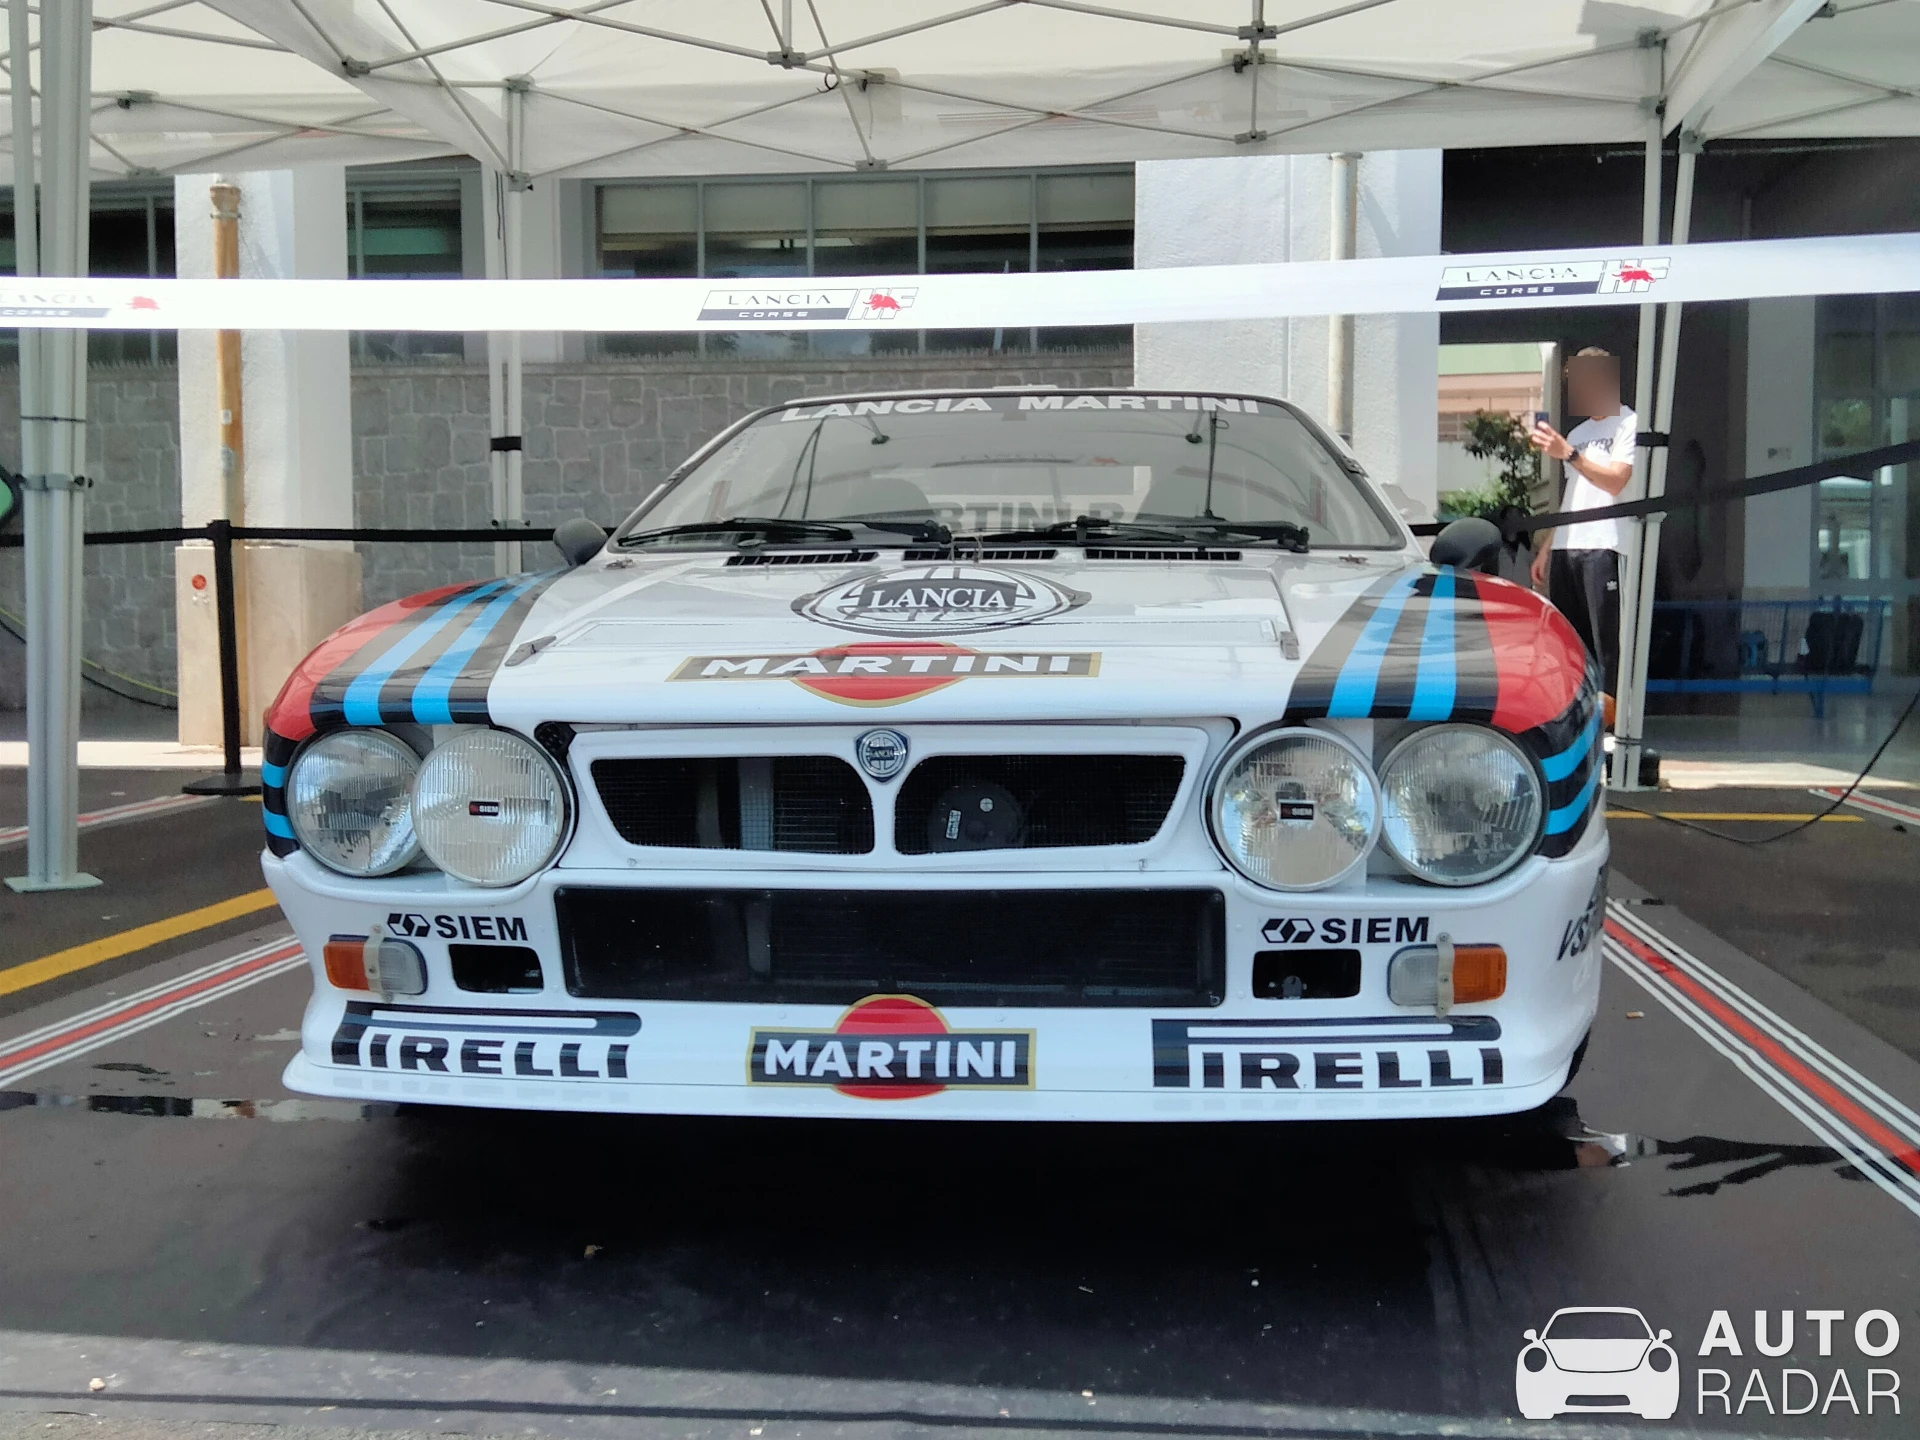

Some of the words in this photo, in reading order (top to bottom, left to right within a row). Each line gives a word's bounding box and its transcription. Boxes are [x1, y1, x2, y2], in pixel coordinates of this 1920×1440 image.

[1466, 267, 1578, 283] LANCIA
[728, 294, 831, 306] LANCIA
[1480, 286, 1555, 296] CORSE
[780, 397, 993, 422] LANCIA
[1018, 395, 1259, 414] MARTINI
[871, 588, 1012, 609] LANCIA
[700, 655, 1071, 676] MARTINI
[479, 804, 499, 814] SIEM
[1291, 807, 1312, 816] SIEM
[437, 915, 528, 941] SIEM
[1320, 917, 1430, 944] SIEM
[332, 1001, 643, 1079] PIRELLI
[764, 1039, 1017, 1079] MARTINI
[1151, 1015, 1503, 1089] PIRELLI
